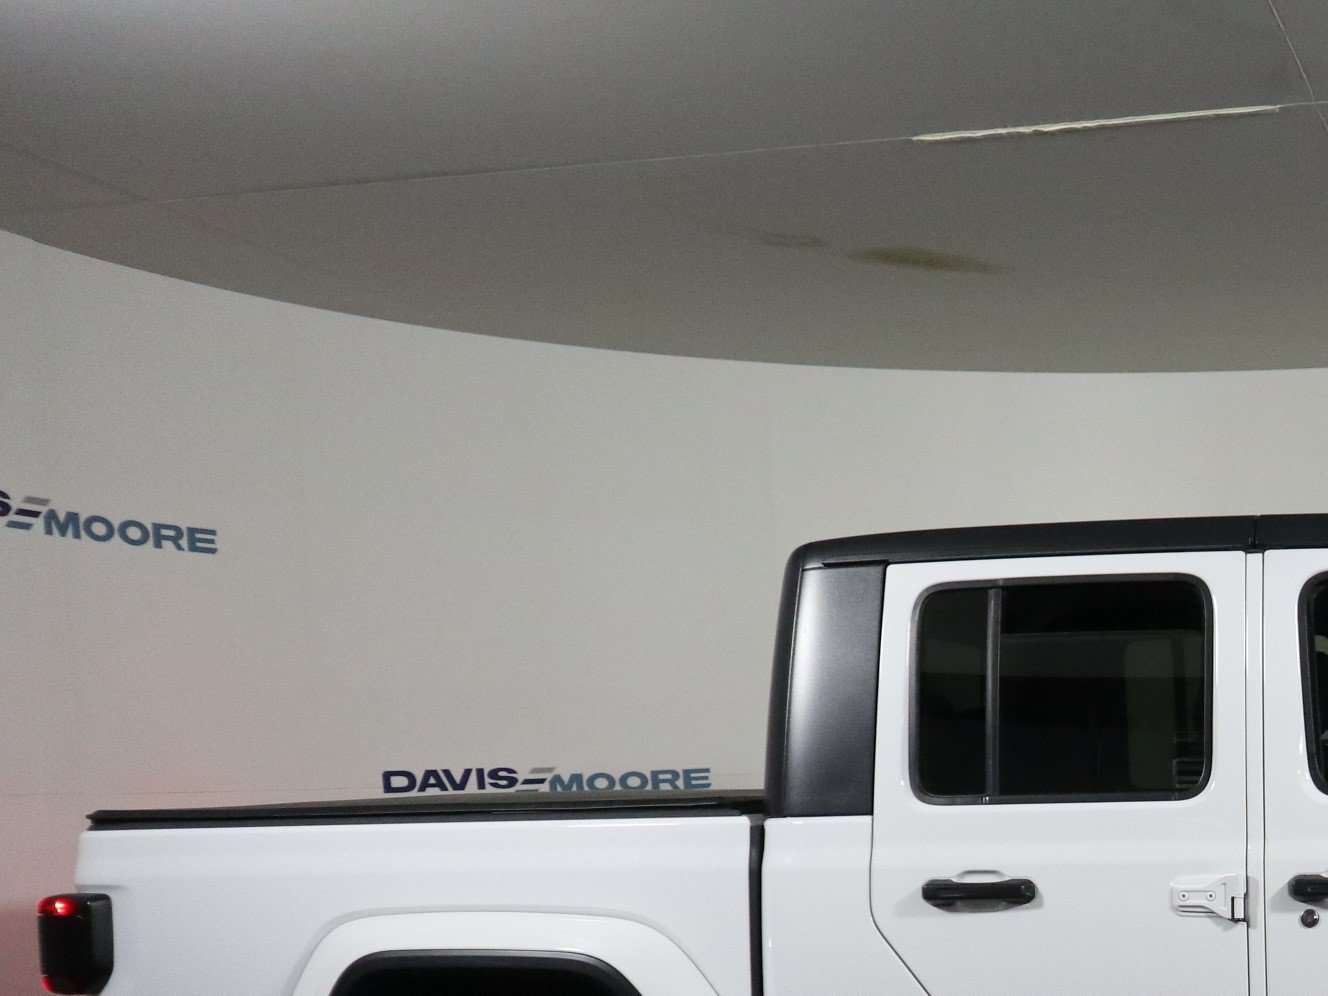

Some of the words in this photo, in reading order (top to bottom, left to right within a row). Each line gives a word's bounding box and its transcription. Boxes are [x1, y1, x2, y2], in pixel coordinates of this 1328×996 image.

[43, 508, 218, 554] MOORE
[382, 767, 519, 793] DAVIS
[549, 768, 711, 792] MOORE
